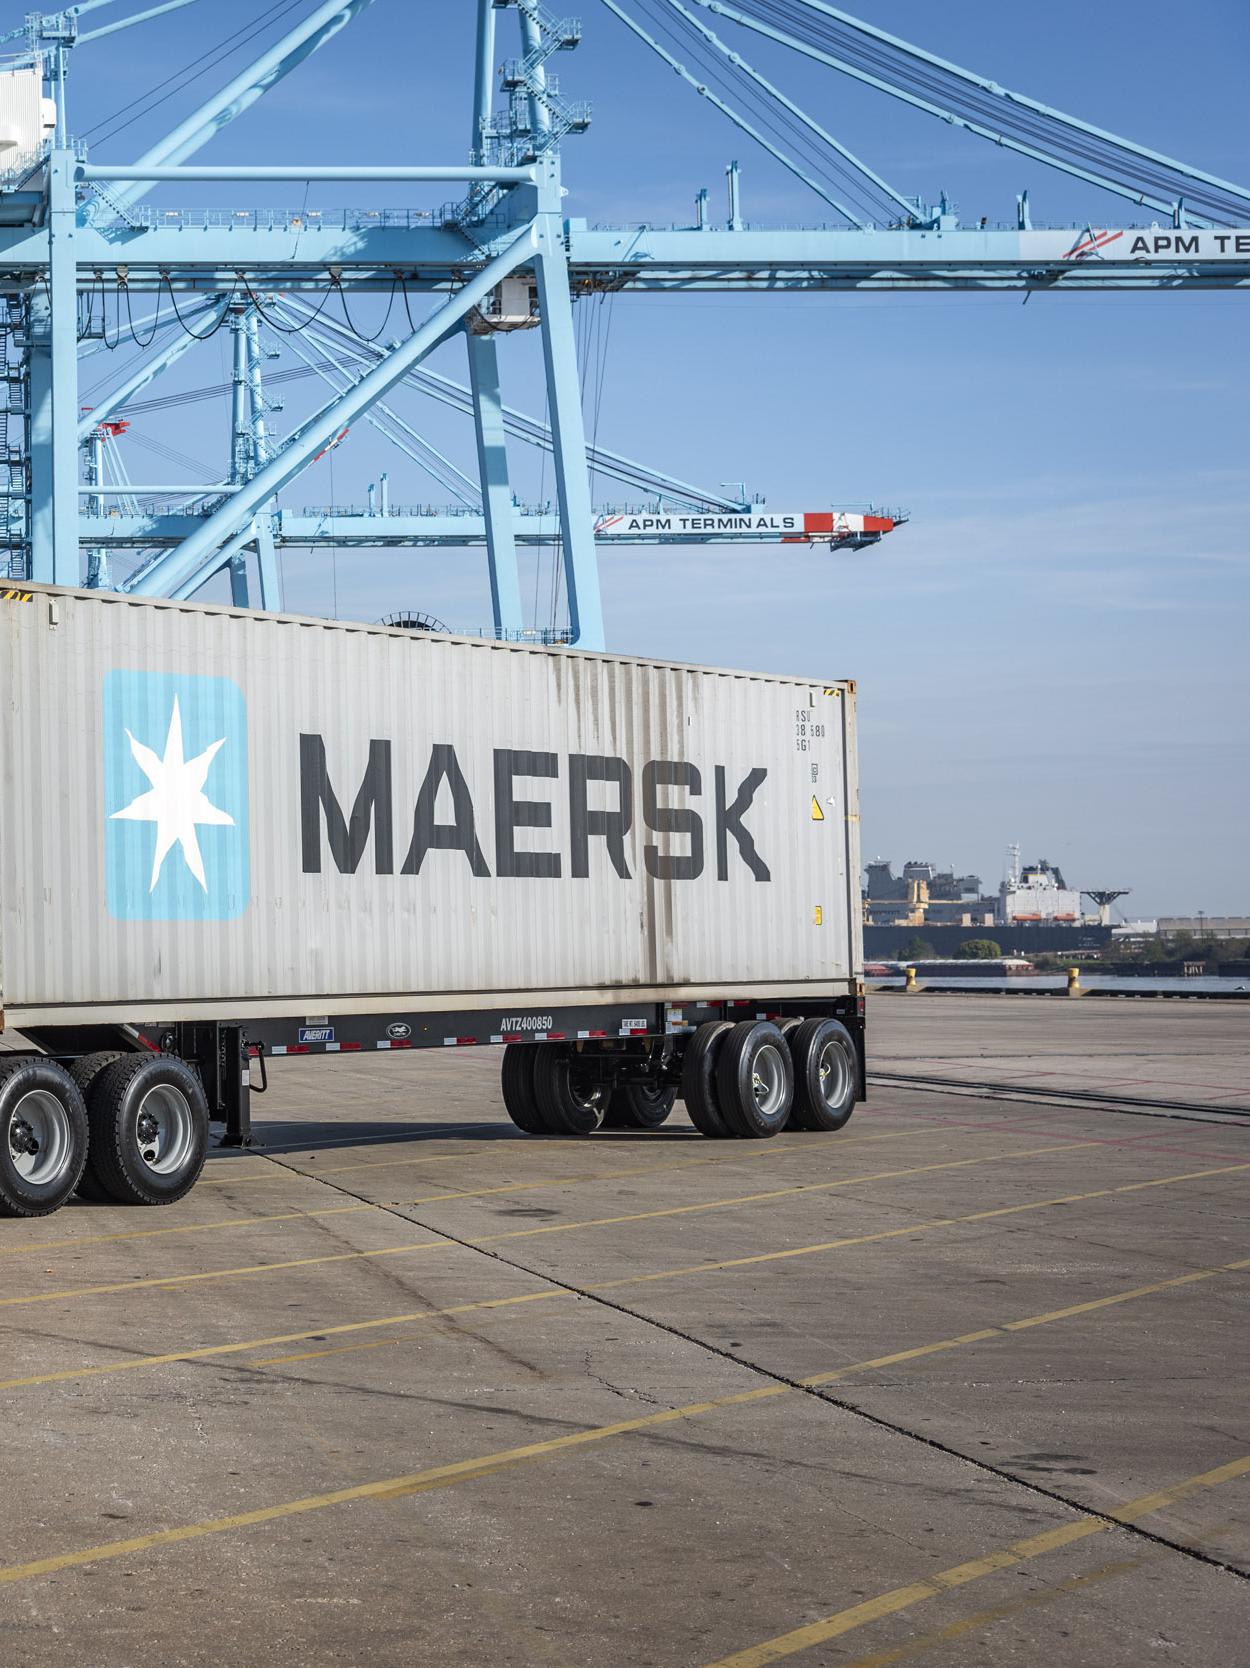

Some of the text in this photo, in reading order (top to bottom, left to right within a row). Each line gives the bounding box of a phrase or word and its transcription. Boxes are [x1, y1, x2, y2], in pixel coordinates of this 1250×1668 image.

[1130, 236, 1199, 253] APM
[628, 516, 795, 530] APM TERMINALS
[299, 733, 772, 882] MAERSK
[500, 1016, 553, 1031] AVTZ400850
[302, 1030, 330, 1040] AVERITT
